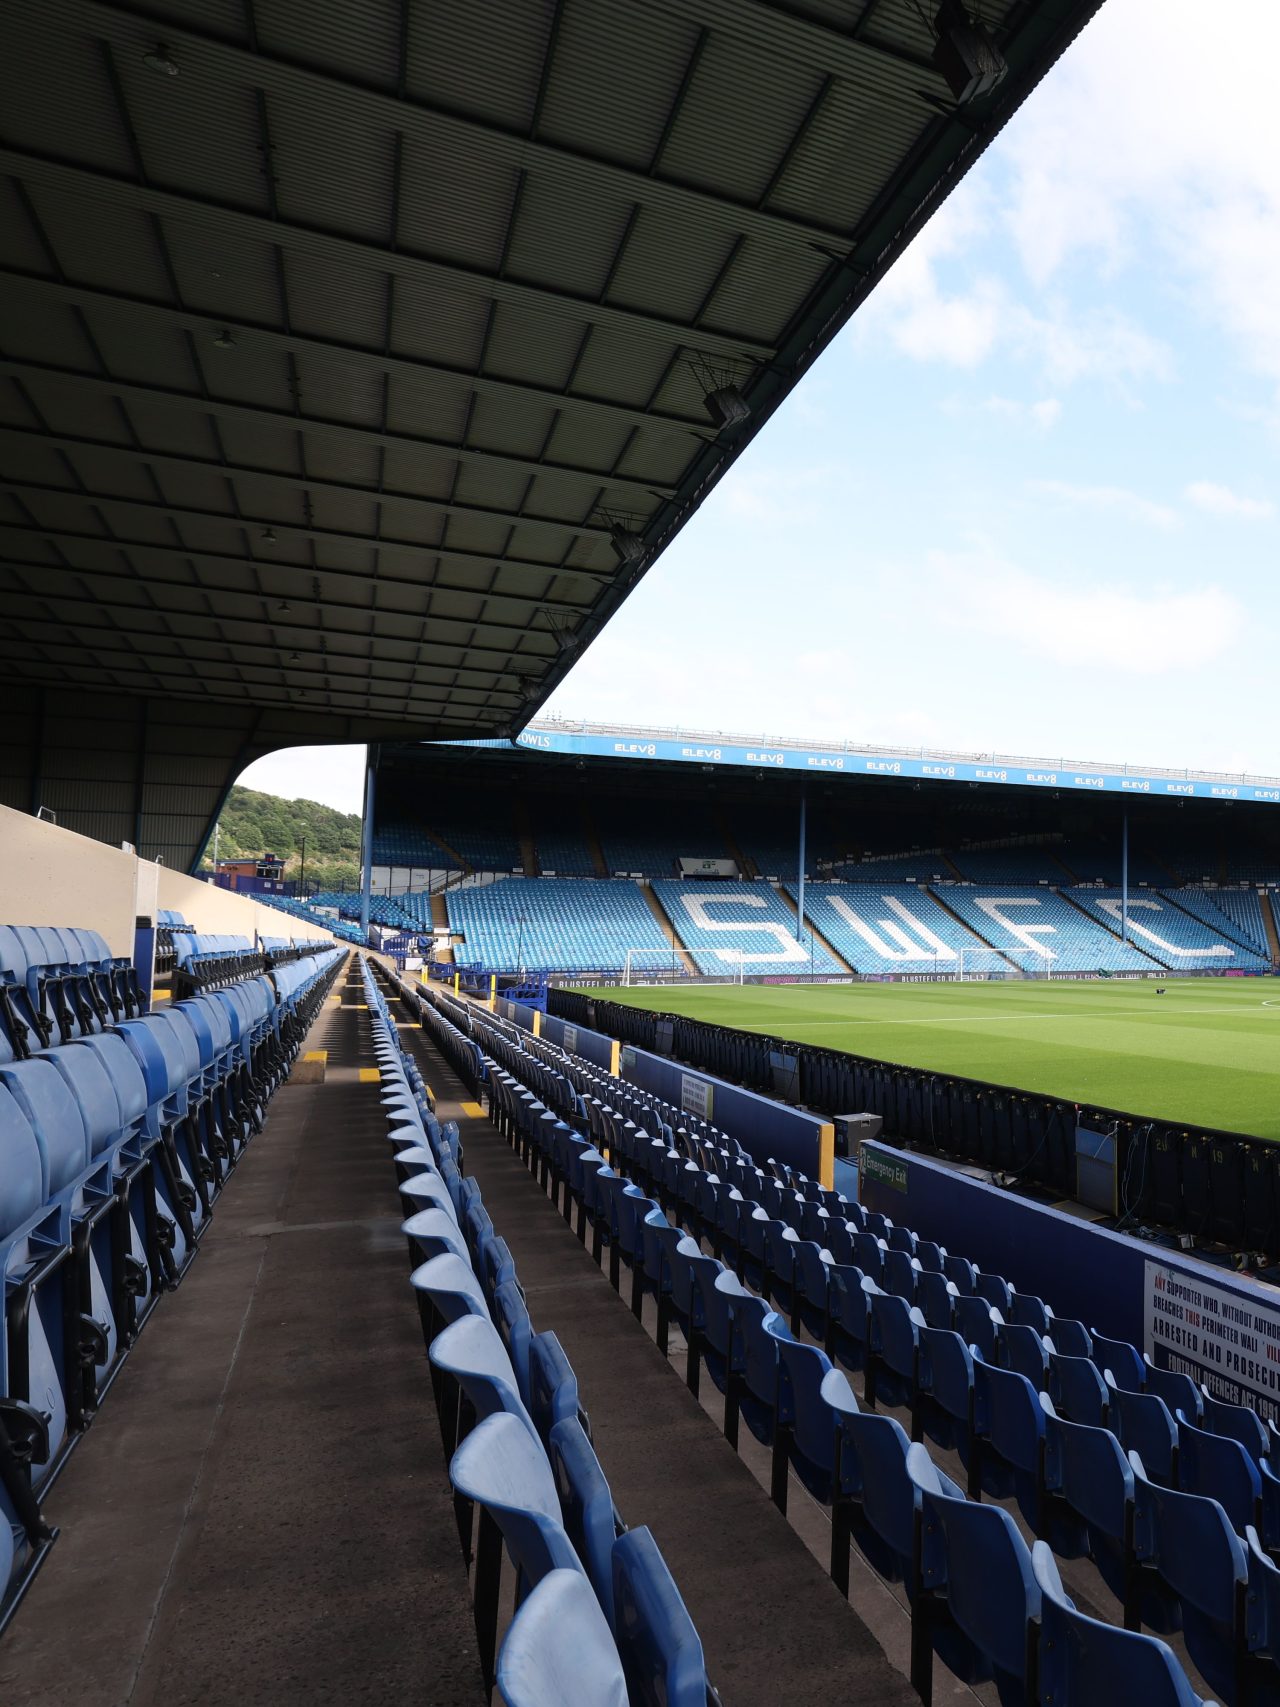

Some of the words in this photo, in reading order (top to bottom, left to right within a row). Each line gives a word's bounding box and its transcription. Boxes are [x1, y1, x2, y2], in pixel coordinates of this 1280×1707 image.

[521, 733, 550, 748] OWLS
[614, 743, 656, 756] ELEV8
[682, 748, 722, 761] ELEV8
[746, 752, 784, 766] ELEV8
[807, 757, 844, 769] ELEV8
[866, 761, 901, 774] ELEV8
[922, 766, 955, 777] ELEV8
[975, 770, 1007, 781] ELEV8
[1026, 773, 1057, 784] ELEV8
[1075, 777, 1104, 788] ELEV8
[1121, 780, 1150, 791] ELEV8
[1167, 784, 1194, 794] ELEV8
[1211, 787, 1238, 797] ELEV8
[1254, 790, 1280, 801] ELEV8
[866, 1155, 895, 1182] Emergency
[895, 1167, 907, 1184] Exit
[1154, 1275, 1166, 1291] ANY
[1166, 1281, 1202, 1306] SUPPORTER
[1203, 1295, 1221, 1317] WHO,
[1221, 1303, 1252, 1328] WITHOUT
[1153, 1295, 1184, 1318] BREACHES
[1185, 1309, 1201, 1328] THIS
[1202, 1316, 1239, 1345] PERIMETER
[1153, 1316, 1198, 1352] ARRESTED
[1202, 1339, 1221, 1363] AND
[1168, 1352, 1201, 1385] FOOTBALL
[1203, 1370, 1239, 1403] OFFENCES
[1241, 1388, 1258, 1411] ACT
[1259, 1397, 1279, 1425] 1991
